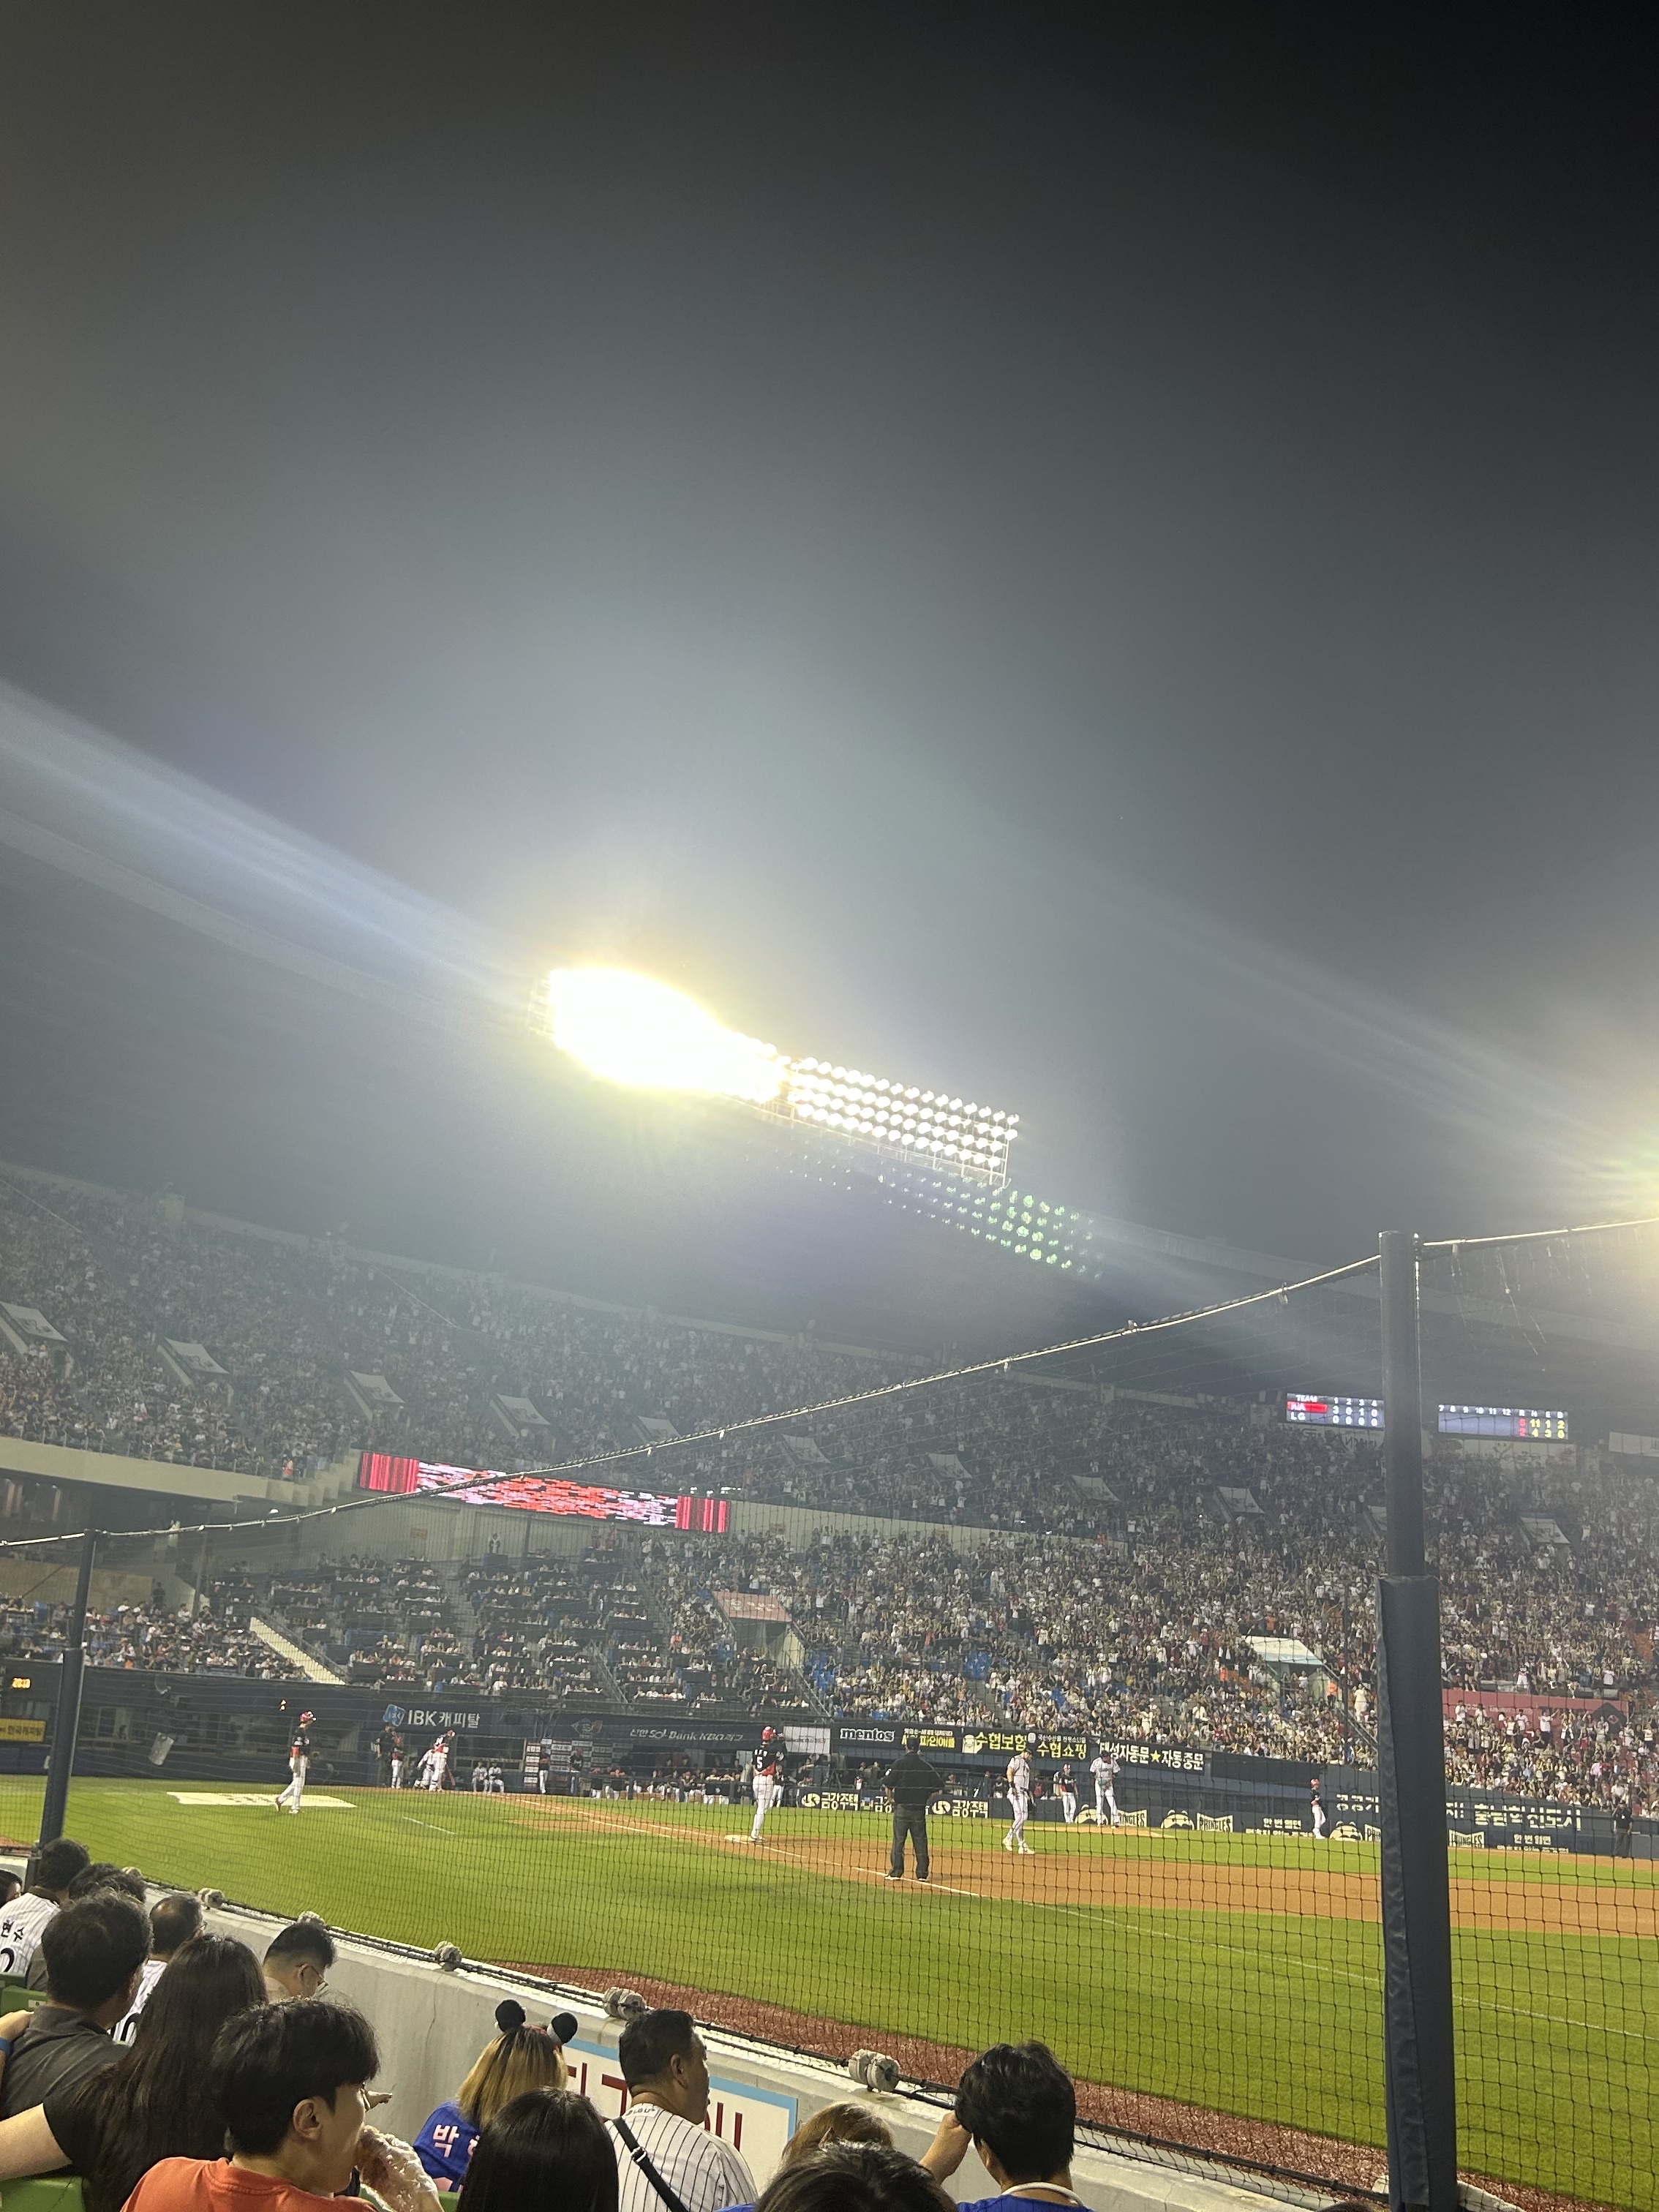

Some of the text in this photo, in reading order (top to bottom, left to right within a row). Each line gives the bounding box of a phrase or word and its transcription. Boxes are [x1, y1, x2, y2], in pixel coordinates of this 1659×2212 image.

[1295, 1394, 1317, 1402] TEAM
[1332, 1405, 1339, 1415] 3
[1345, 1407, 1353, 1415] 0
[1371, 1409, 1378, 1417] 0
[1489, 1407, 1497, 1415] 11
[1290, 1412, 1378, 1426] LG 0 0 0 0
[1530, 1418, 1540, 1428] 11
[1545, 1420, 1551, 1428] 1
[1557, 1420, 1565, 1429] 2
[1519, 1427, 1526, 1437] 2
[1531, 1428, 1538, 1437] 4
[840, 1728, 895, 1742] mentos
[974, 1731, 1027, 1751] 수협보험
[1037, 1740, 1087, 1760] 수협쇼핑
[756, 1756, 763, 1769] 5
[821, 1792, 859, 1812] 금강주택
[952, 1799, 988, 1818] 금강주택
[1199, 1816, 1231, 1832] PRINGLES
